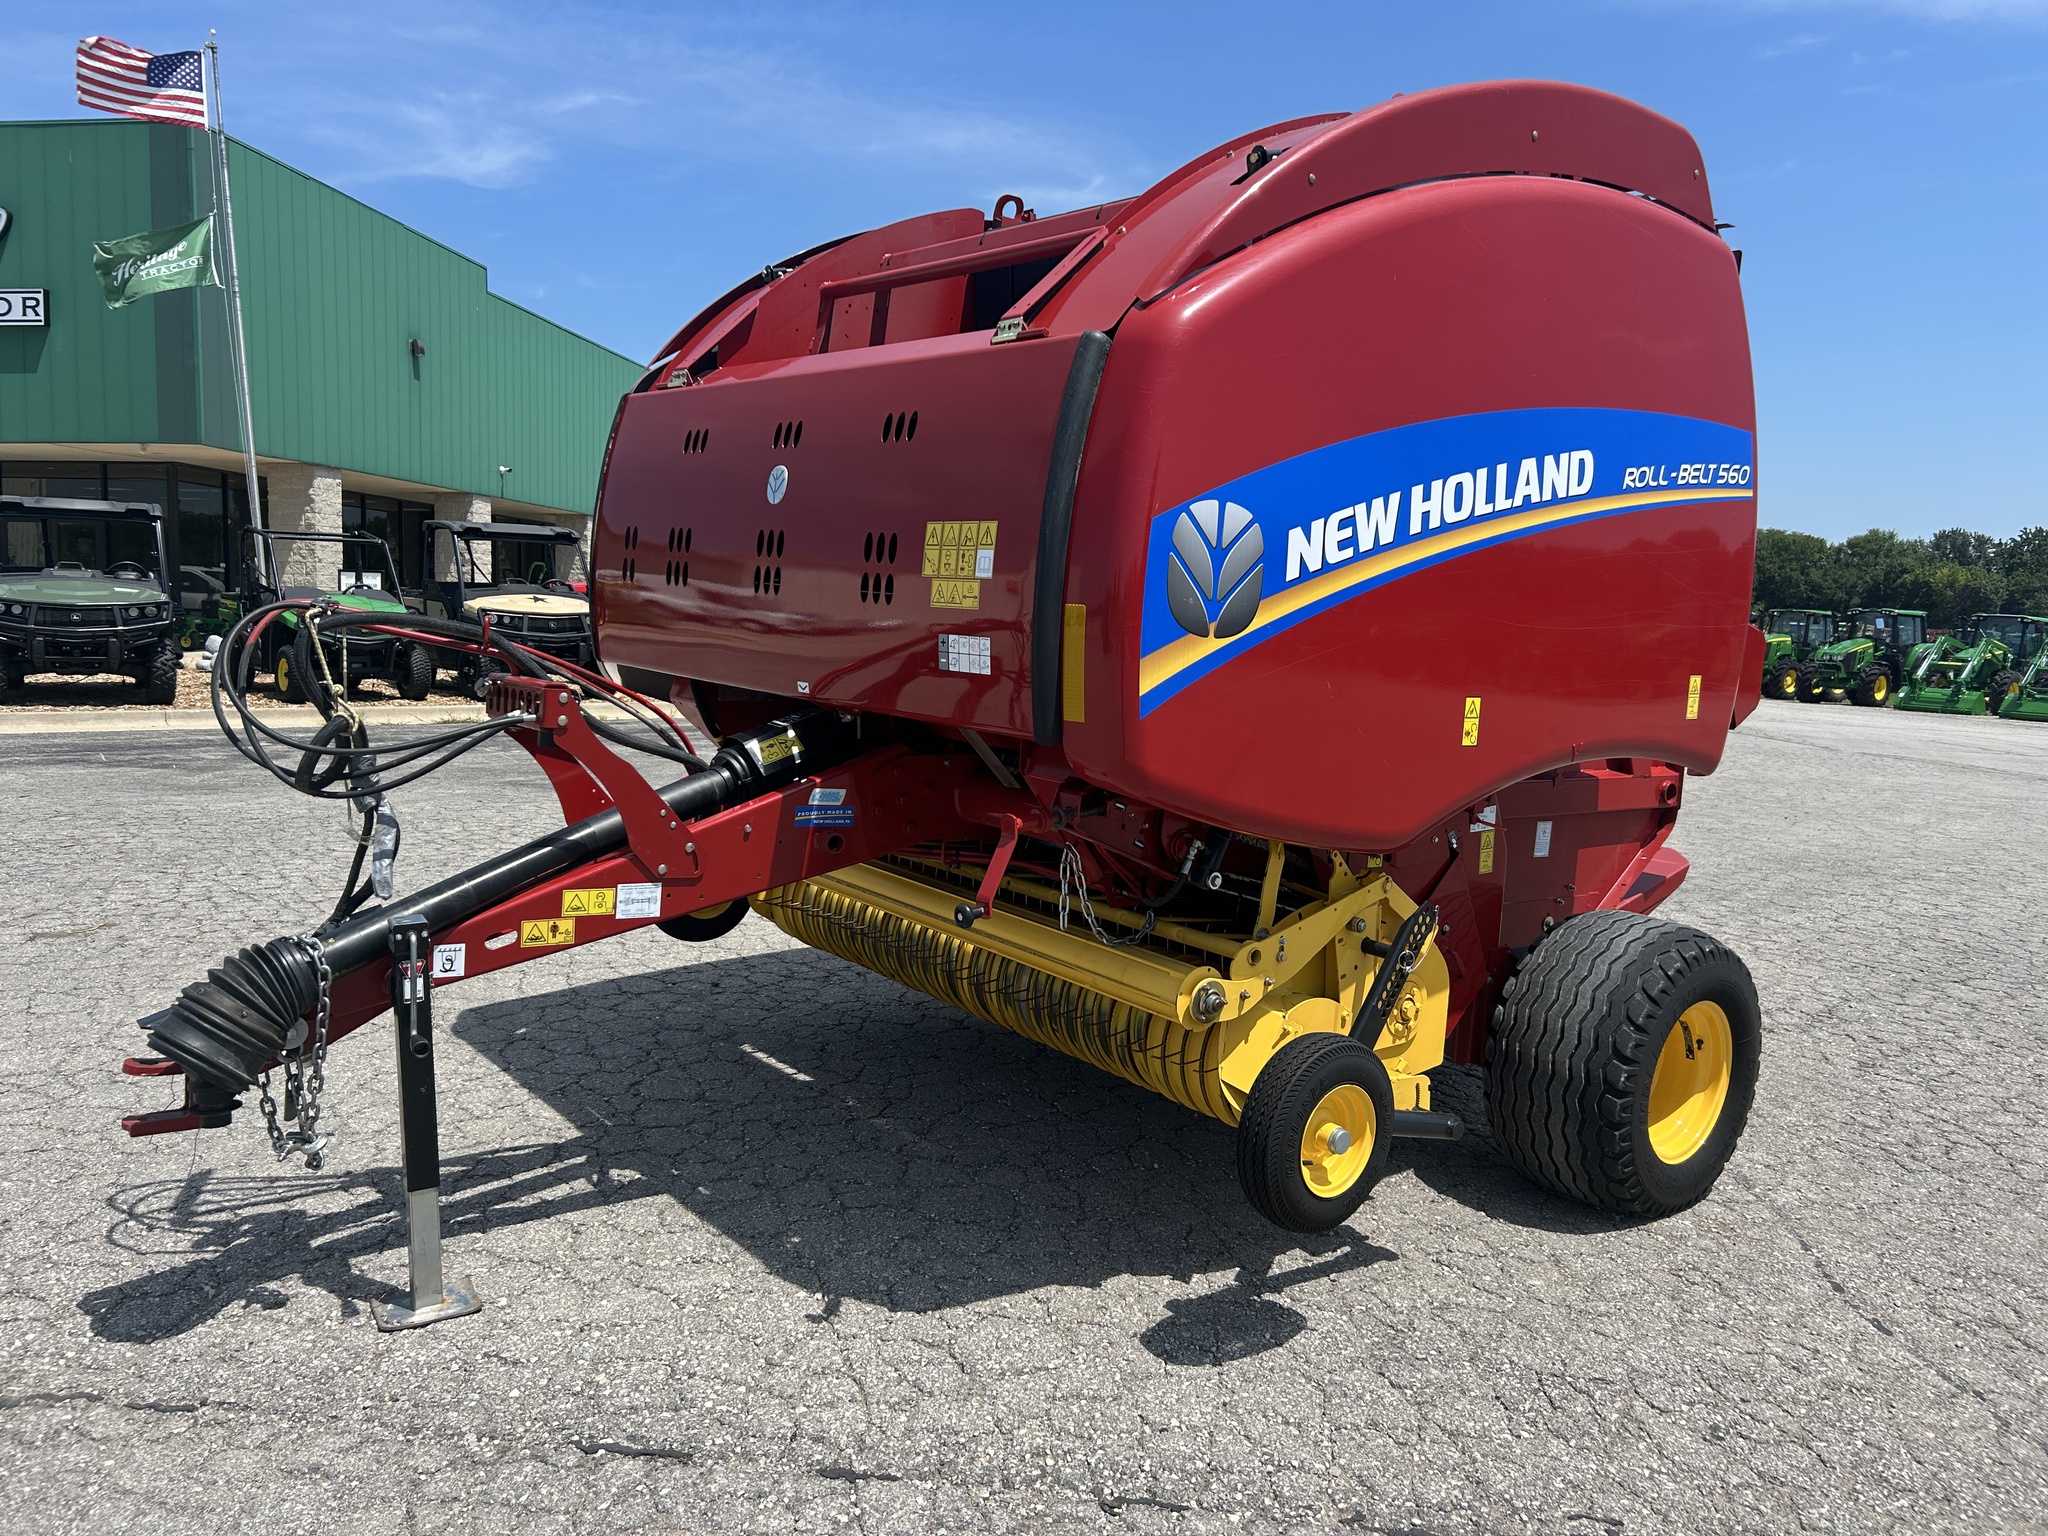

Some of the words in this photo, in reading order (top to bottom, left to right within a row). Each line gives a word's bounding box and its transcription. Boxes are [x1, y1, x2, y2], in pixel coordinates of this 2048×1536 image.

[139, 257, 203, 278] TRACTOR
[1622, 464, 1717, 490] ROLL-BELT
[1716, 464, 1750, 485] 560
[1286, 490, 1401, 582] NEW
[1409, 449, 1594, 535] HOLLAND
